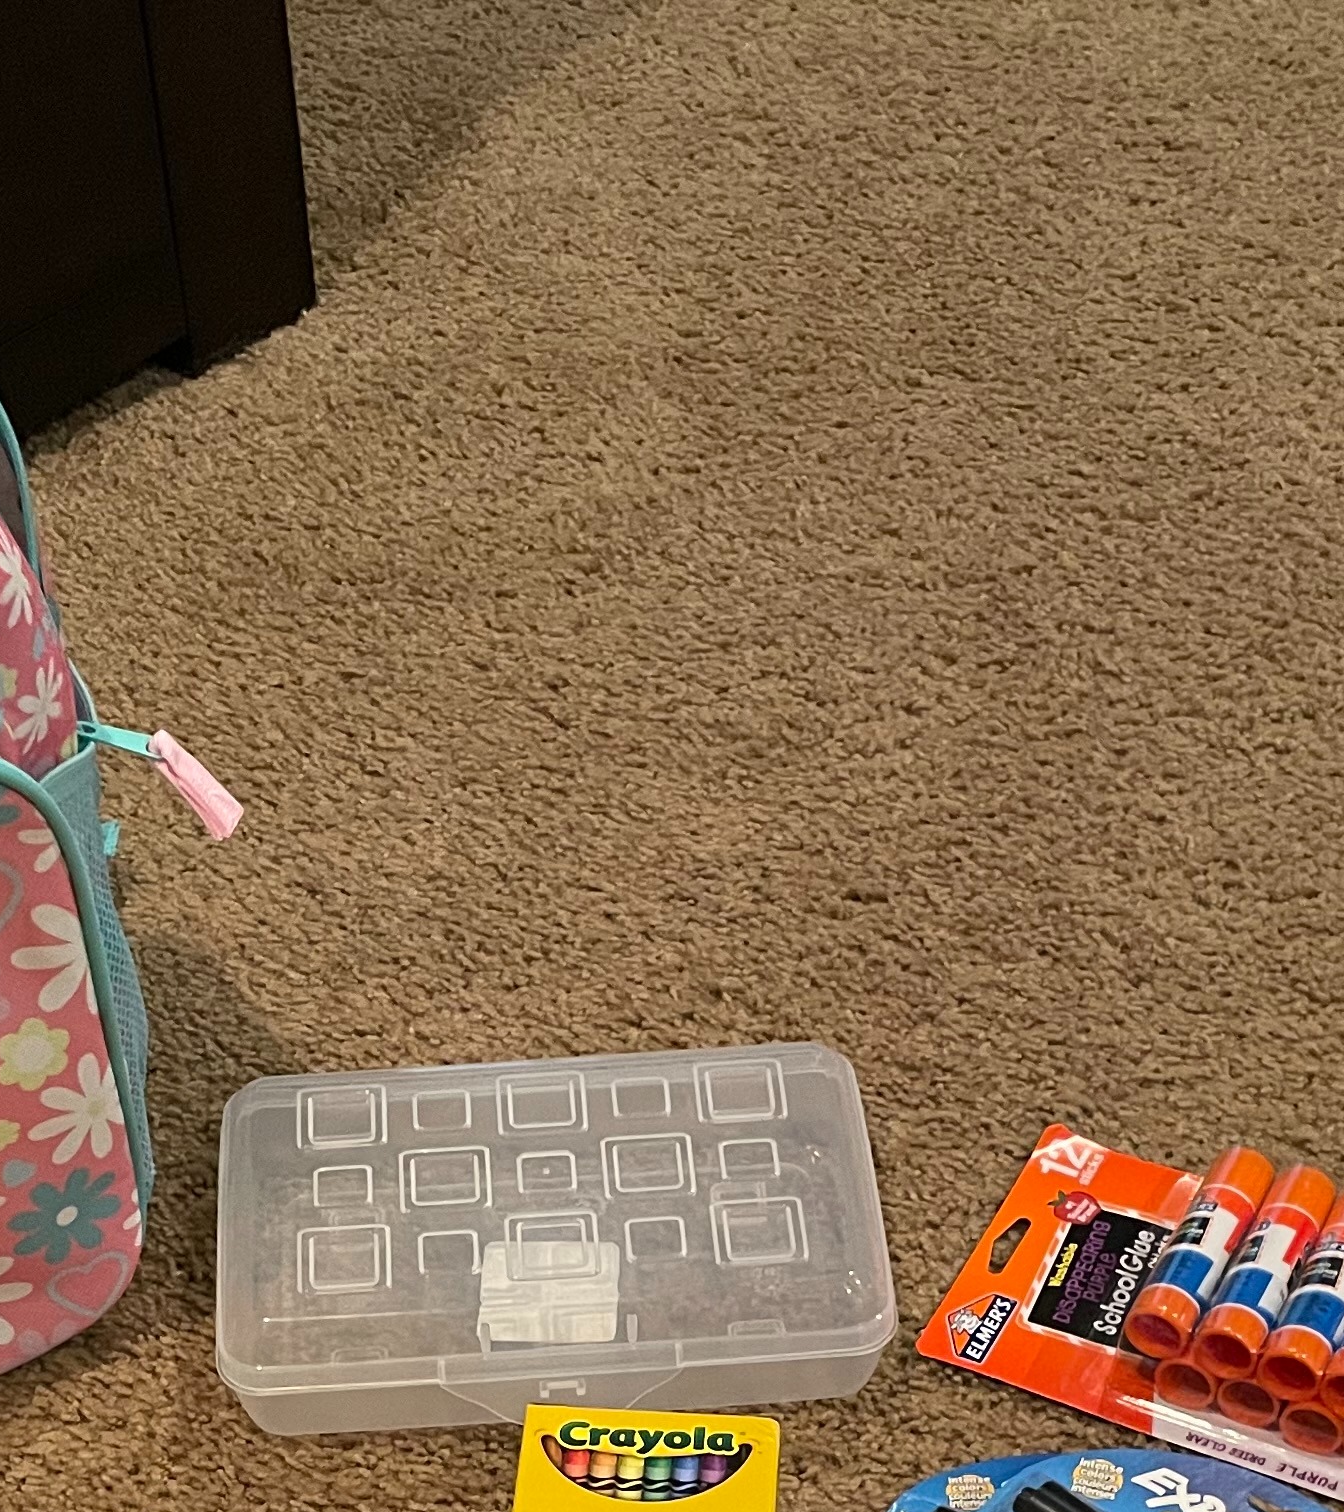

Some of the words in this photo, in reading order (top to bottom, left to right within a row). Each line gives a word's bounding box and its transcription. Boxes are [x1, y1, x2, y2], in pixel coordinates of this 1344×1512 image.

[1040, 1138, 1092, 1178] 12
[965, 1298, 1014, 1361] ELMER'S
[559, 1421, 735, 1453] Crayola
[1275, 1461, 1340, 1491] PURPLE
